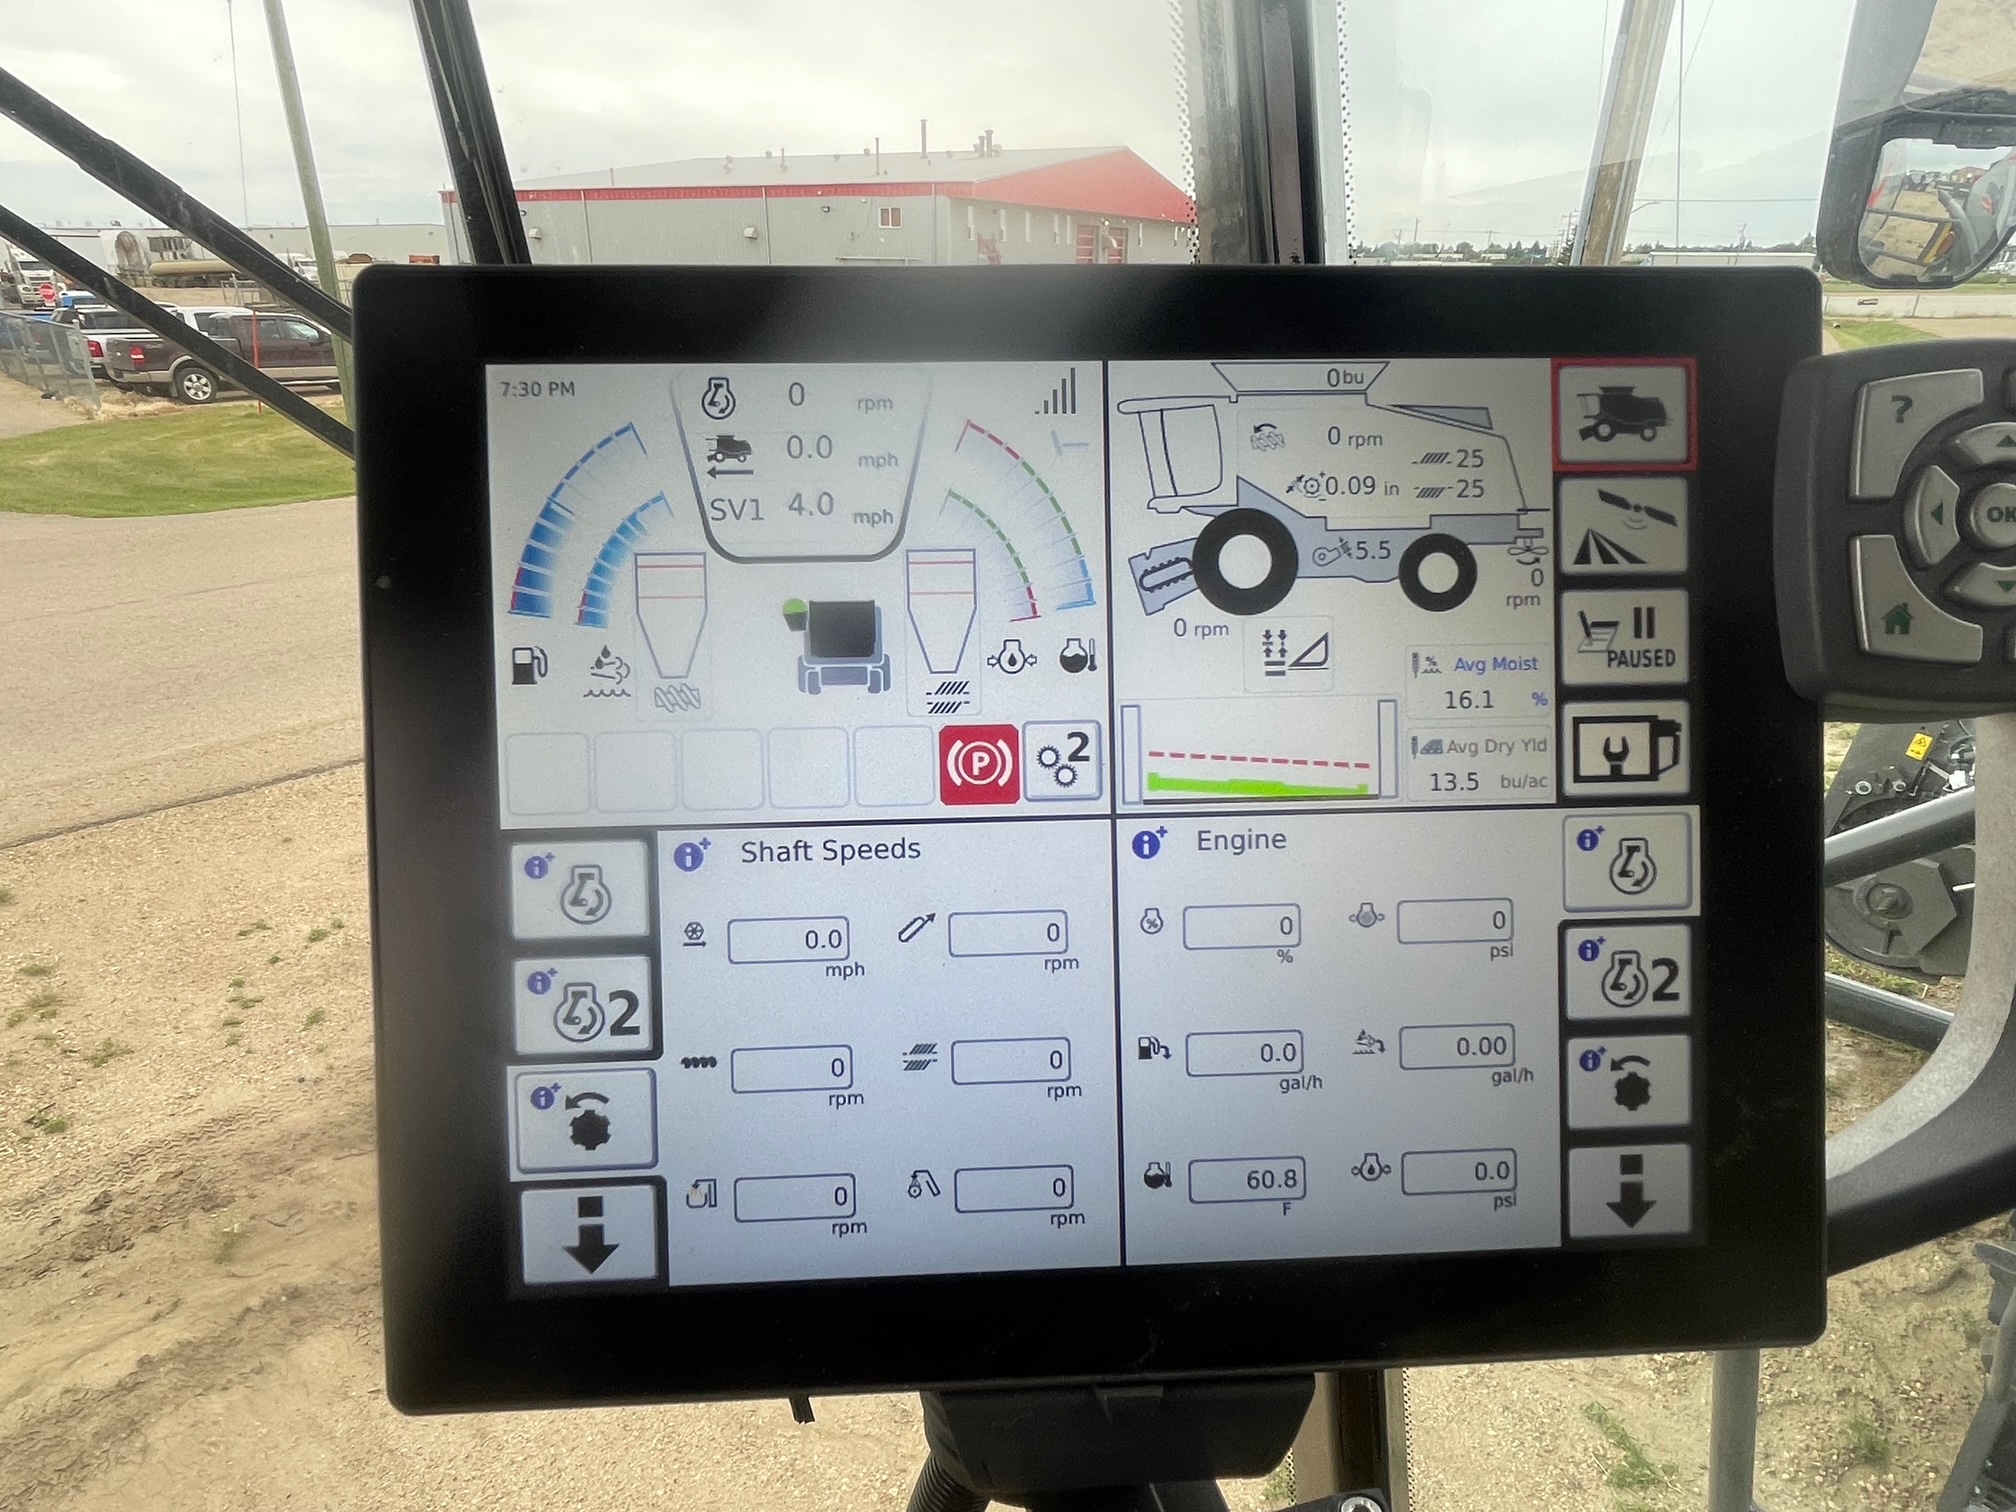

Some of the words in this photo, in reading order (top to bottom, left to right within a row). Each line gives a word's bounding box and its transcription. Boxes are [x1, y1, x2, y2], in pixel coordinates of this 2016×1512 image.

[500, 382, 542, 397] 7:30
[550, 381, 575, 396] PM
[788, 382, 805, 406] 0
[858, 398, 893, 414] rpm
[1328, 426, 1341, 445] 0
[1348, 433, 1383, 447] rpm
[787, 435, 833, 459] 0.0
[858, 453, 898, 469] mph
[1456, 449, 1484, 468] 25
[1325, 475, 1376, 496] 0.09
[1384, 481, 1400, 496] in
[1456, 479, 1485, 498] 25
[711, 498, 764, 521] SV1
[788, 491, 835, 515] 4.0
[853, 509, 894, 527] mph
[1355, 540, 1391, 560] 5.5
[1532, 568, 1544, 587] 0
[1506, 594, 1540, 609] rpm
[1173, 618, 1187, 637] 0
[1194, 623, 1229, 640] rpm
[1454, 657, 1487, 676] Avg
[1492, 656, 1539, 671] Moist
[1607, 648, 1676, 668] PAUSED
[1445, 690, 1494, 710] 16.1
[1532, 692, 1548, 706] %
[1067, 731, 1090, 762] 2
[1446, 740, 1479, 757] Avg
[1485, 738, 1515, 757] Dry
[1521, 737, 1547, 753] Yld
[1430, 772, 1480, 792] 13.5
[1500, 774, 1548, 789] bu/ac
[741, 839, 813, 864] Shaft
[823, 837, 921, 866] Speeds
[1198, 828, 1287, 856] Engine
[1280, 916, 1293, 935] 0
[1492, 910, 1506, 929] 0
[805, 929, 843, 949] 0.0
[1047, 923, 1060, 942] 0
[1277, 949, 1294, 963] %
[1490, 943, 1514, 961] psi
[826, 962, 866, 981] mph
[1044, 955, 1080, 973] rpm
[1652, 957, 1680, 1002] 2
[608, 989, 641, 1037] 2
[1260, 1042, 1296, 1062] 0.0
[1457, 1036, 1507, 1056] 0.00
[831, 1058, 845, 1077] 0
[1050, 1050, 1063, 1069] 0
[1279, 1075, 1323, 1094] gal/h
[1491, 1068, 1534, 1087] gal/h
[829, 1092, 864, 1110] rpm
[1047, 1084, 1082, 1101] rpm
[1247, 1169, 1297, 1190] 60.8
[1475, 1161, 1510, 1181] 0.0
[834, 1187, 847, 1206] 0
[1053, 1178, 1065, 1197] 0
[1283, 1202, 1291, 1216] F
[1494, 1192, 1517, 1211] psi
[832, 1221, 867, 1238] rpm
[1050, 1212, 1085, 1229] rpm
